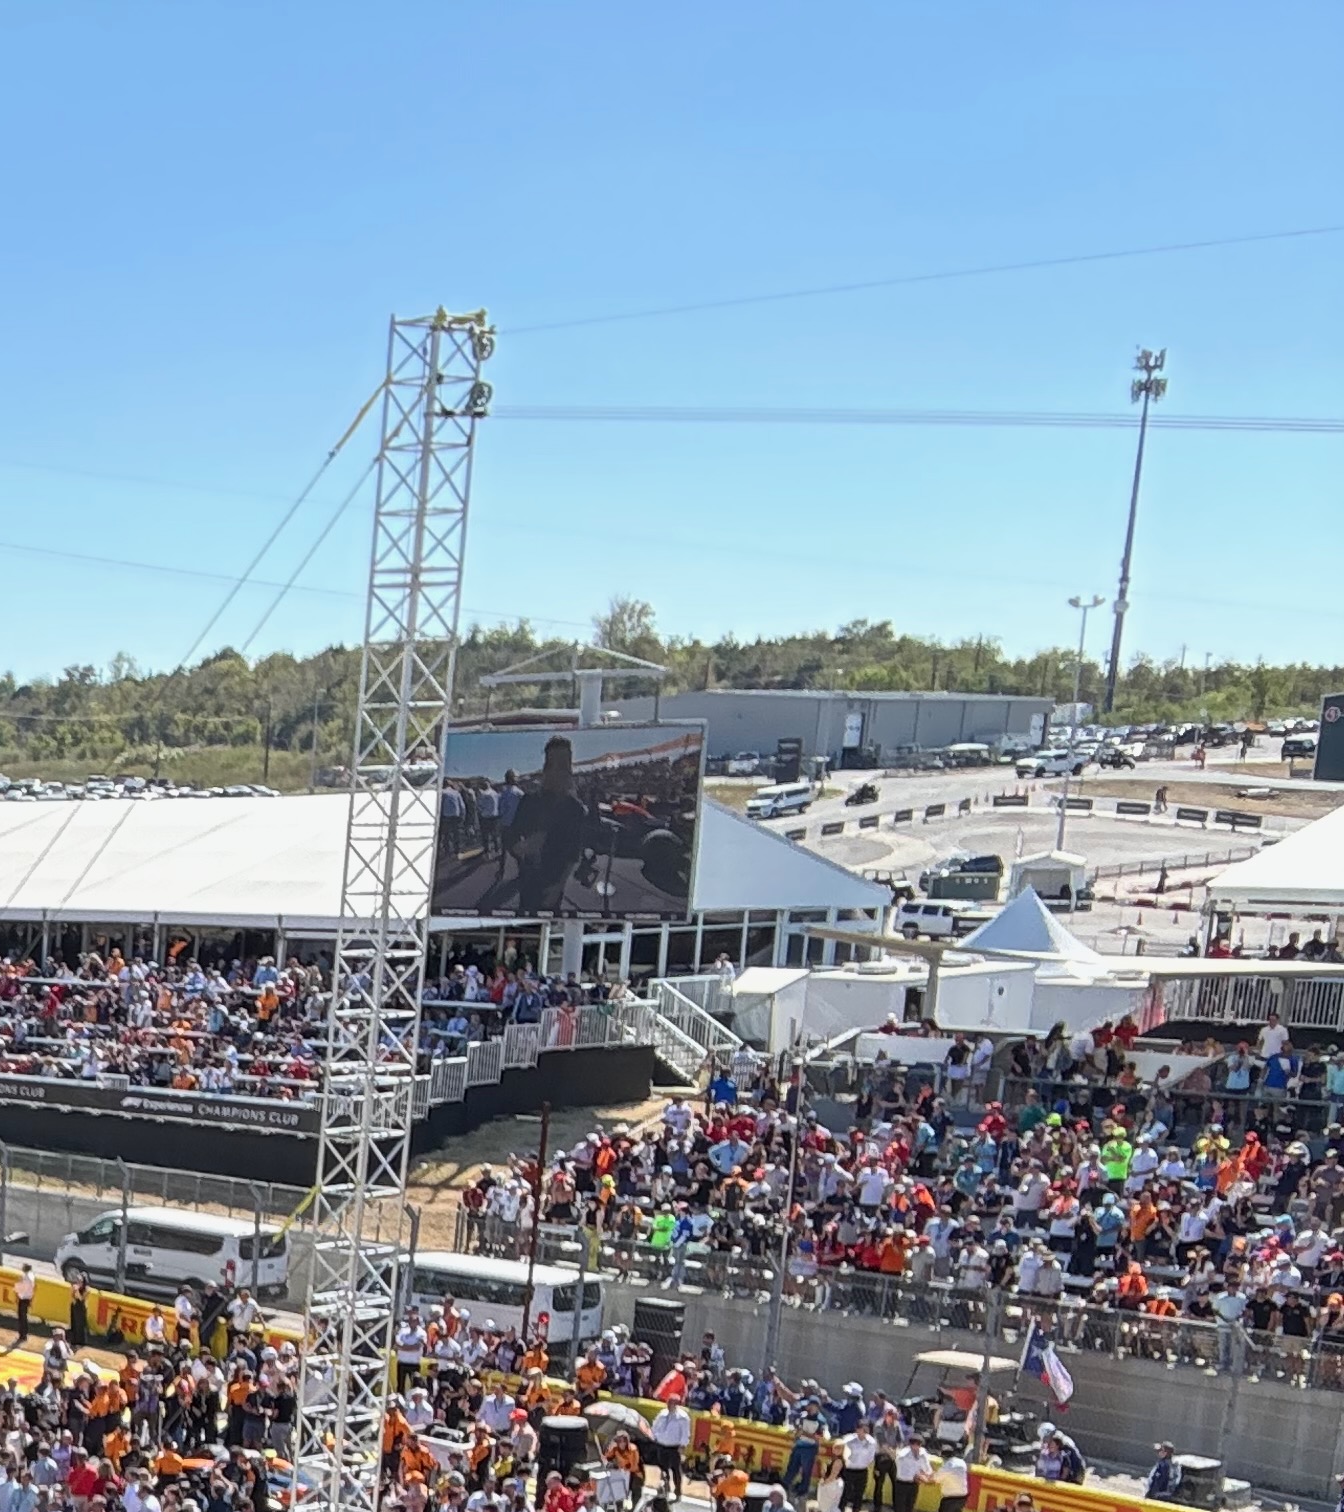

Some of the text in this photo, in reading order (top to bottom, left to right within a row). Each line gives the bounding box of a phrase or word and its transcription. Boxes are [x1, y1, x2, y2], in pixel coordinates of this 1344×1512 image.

[19, 1086, 45, 1098] CLUB
[198, 1103, 266, 1122] CHAMPIONS
[268, 1111, 299, 1126] CLUB
